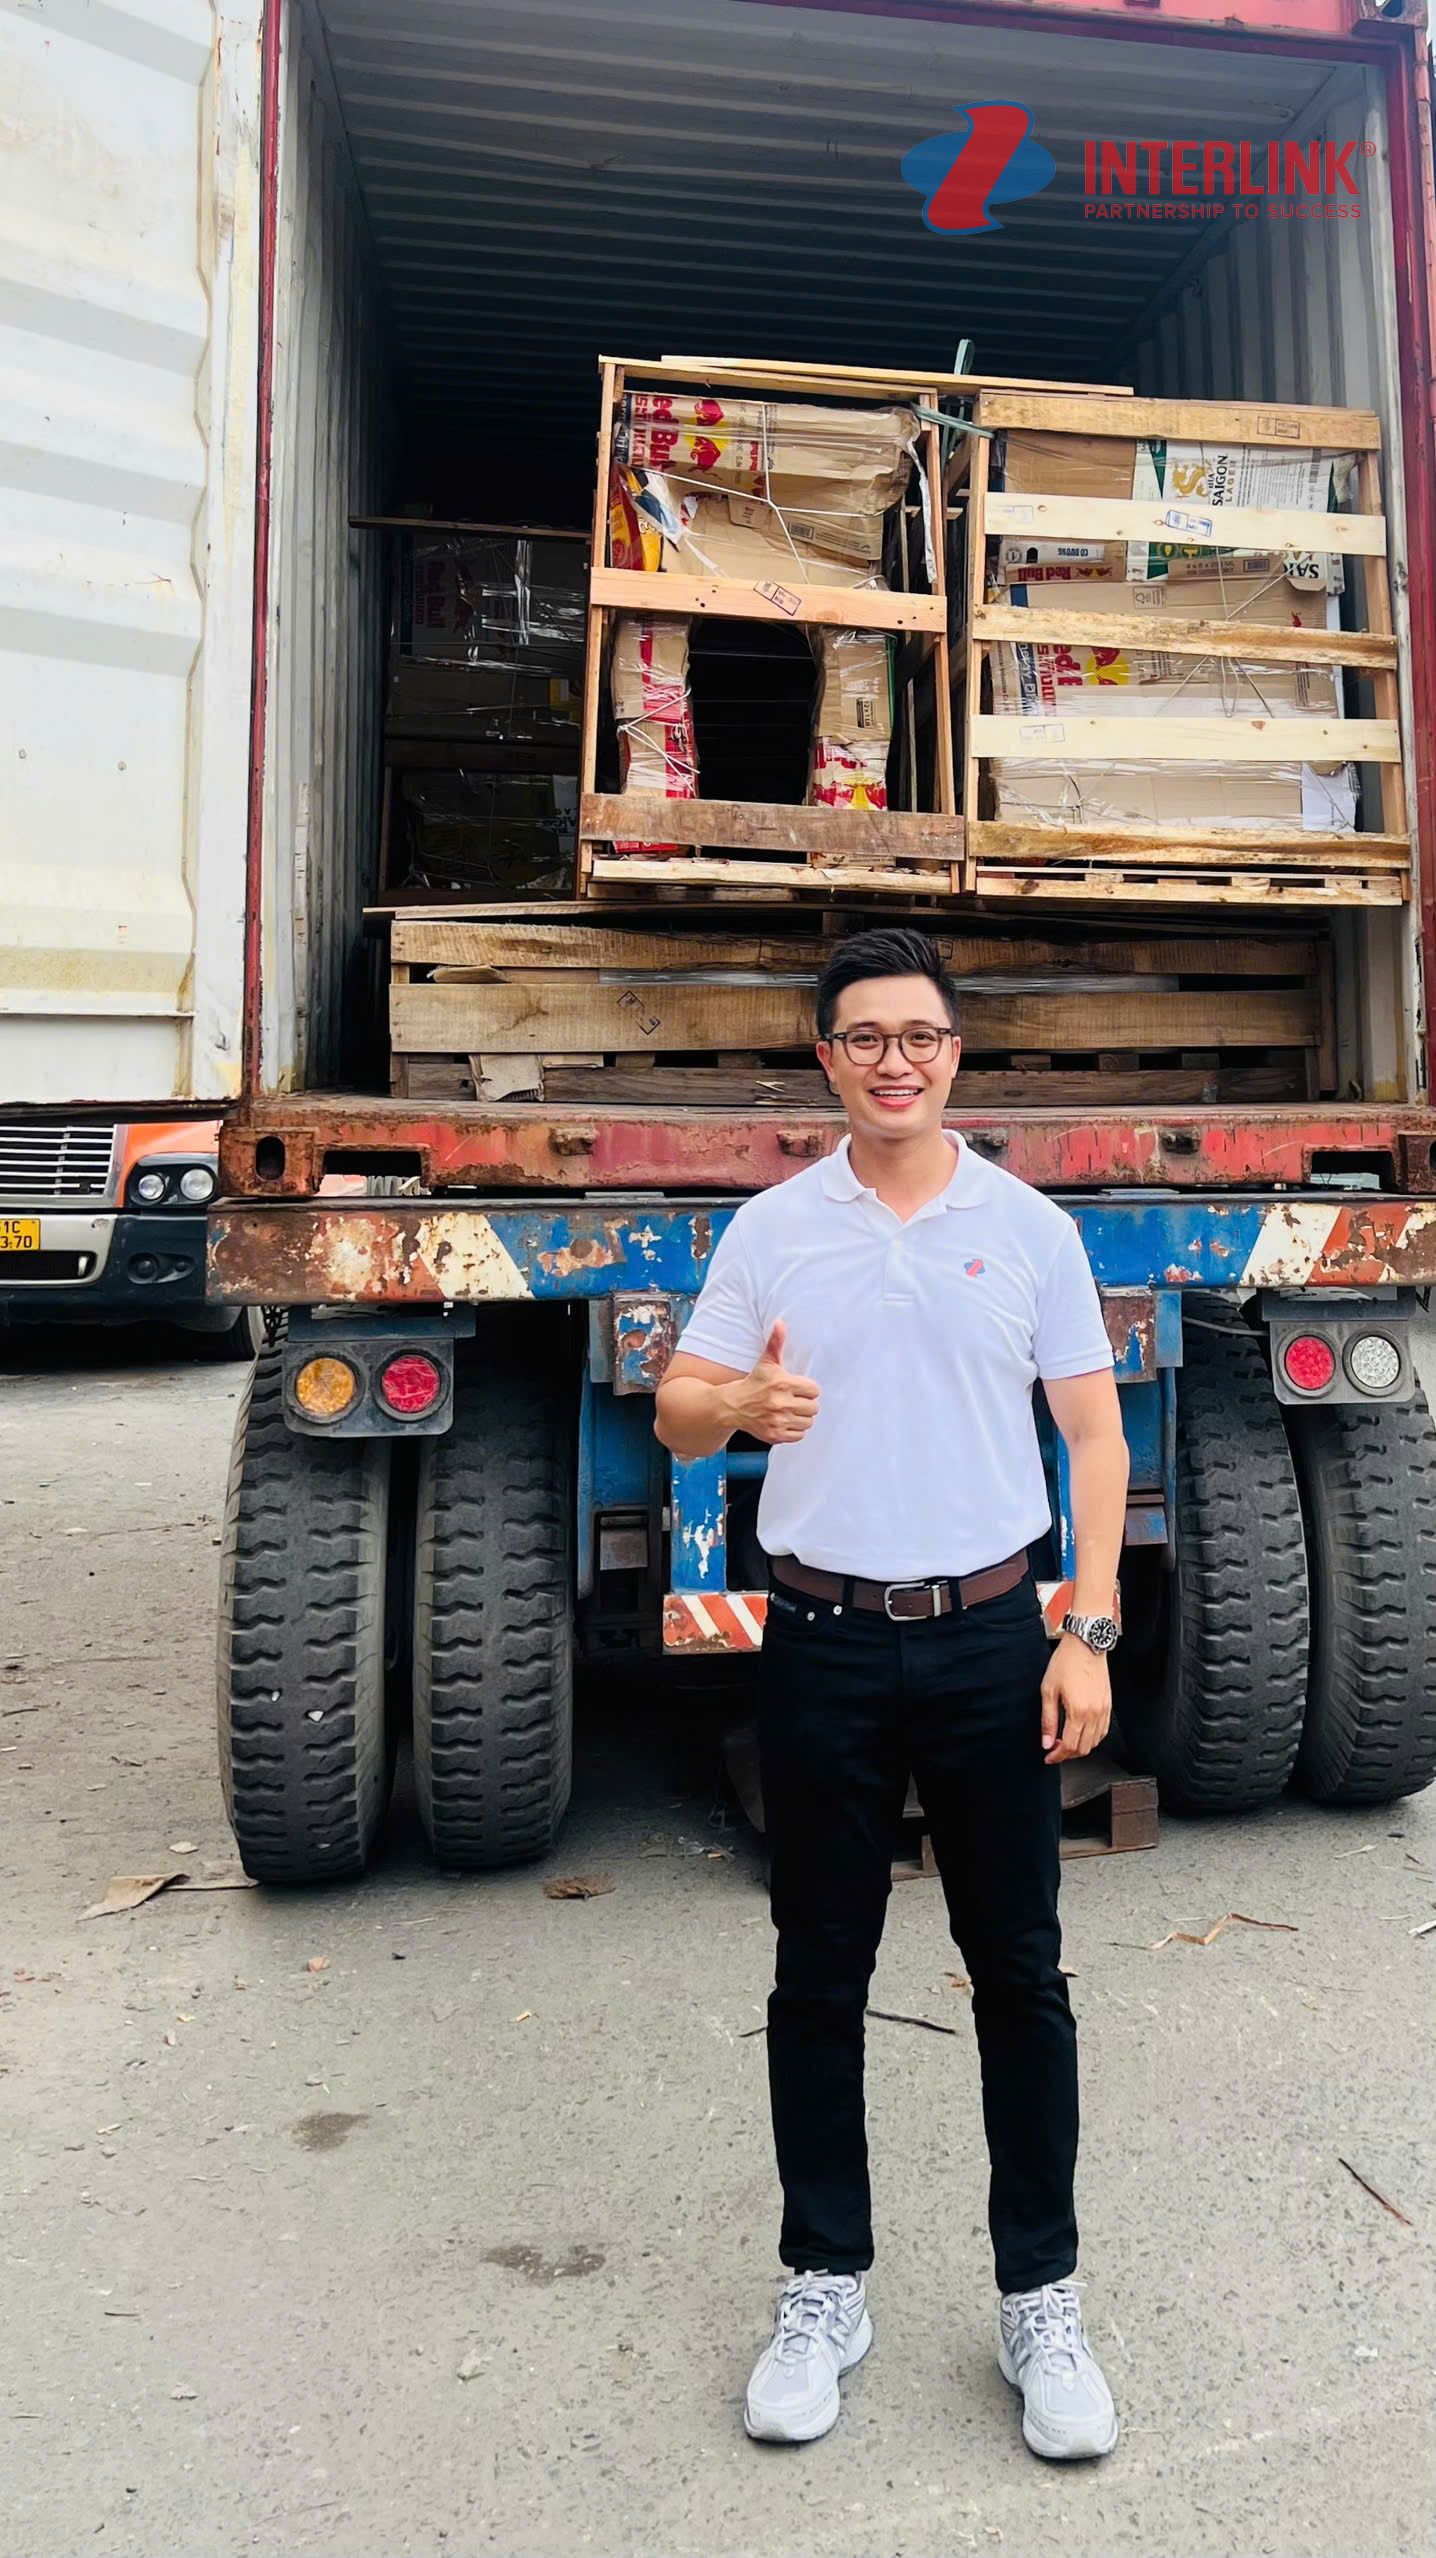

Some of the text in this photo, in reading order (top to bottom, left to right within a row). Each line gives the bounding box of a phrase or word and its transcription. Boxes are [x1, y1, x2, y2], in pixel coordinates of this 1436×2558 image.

[652, 396, 679, 423] ed
[1212, 455, 1228, 506] SAIGON
[1225, 460, 1236, 502] LAGER
[1017, 566, 1071, 582] Red Bull
[1053, 644, 1081, 673] ed
[0, 1221, 20, 1234] 1C
